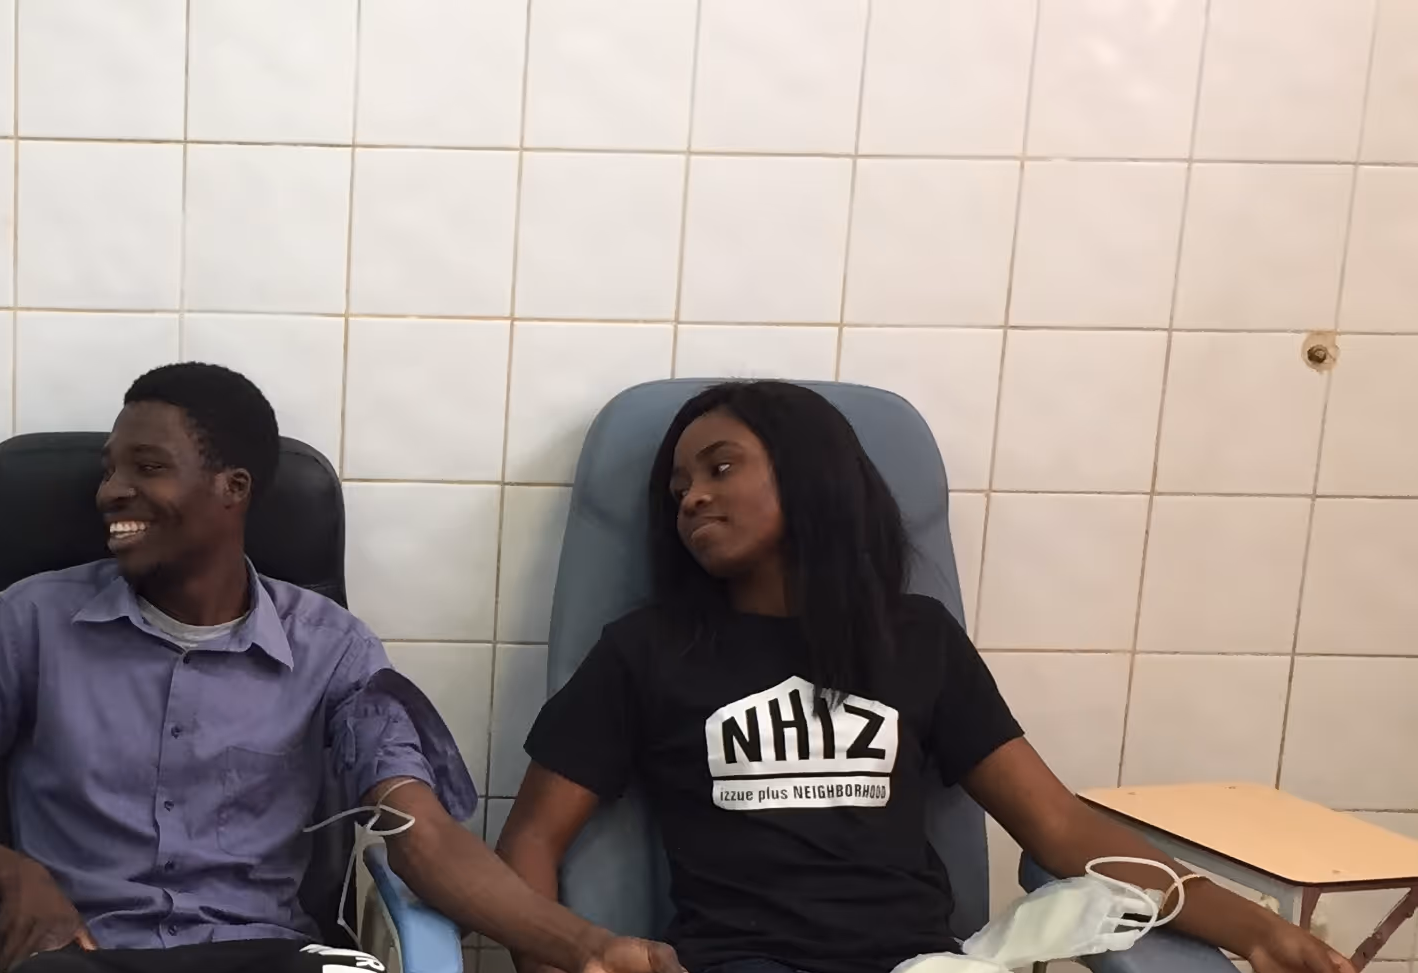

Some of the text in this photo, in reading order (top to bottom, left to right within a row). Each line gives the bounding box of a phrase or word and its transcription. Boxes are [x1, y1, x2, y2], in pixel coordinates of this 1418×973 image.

[722, 689, 886, 764] NHIZ
[720, 783, 886, 803] izzue plus NEIGHBORHOOD
